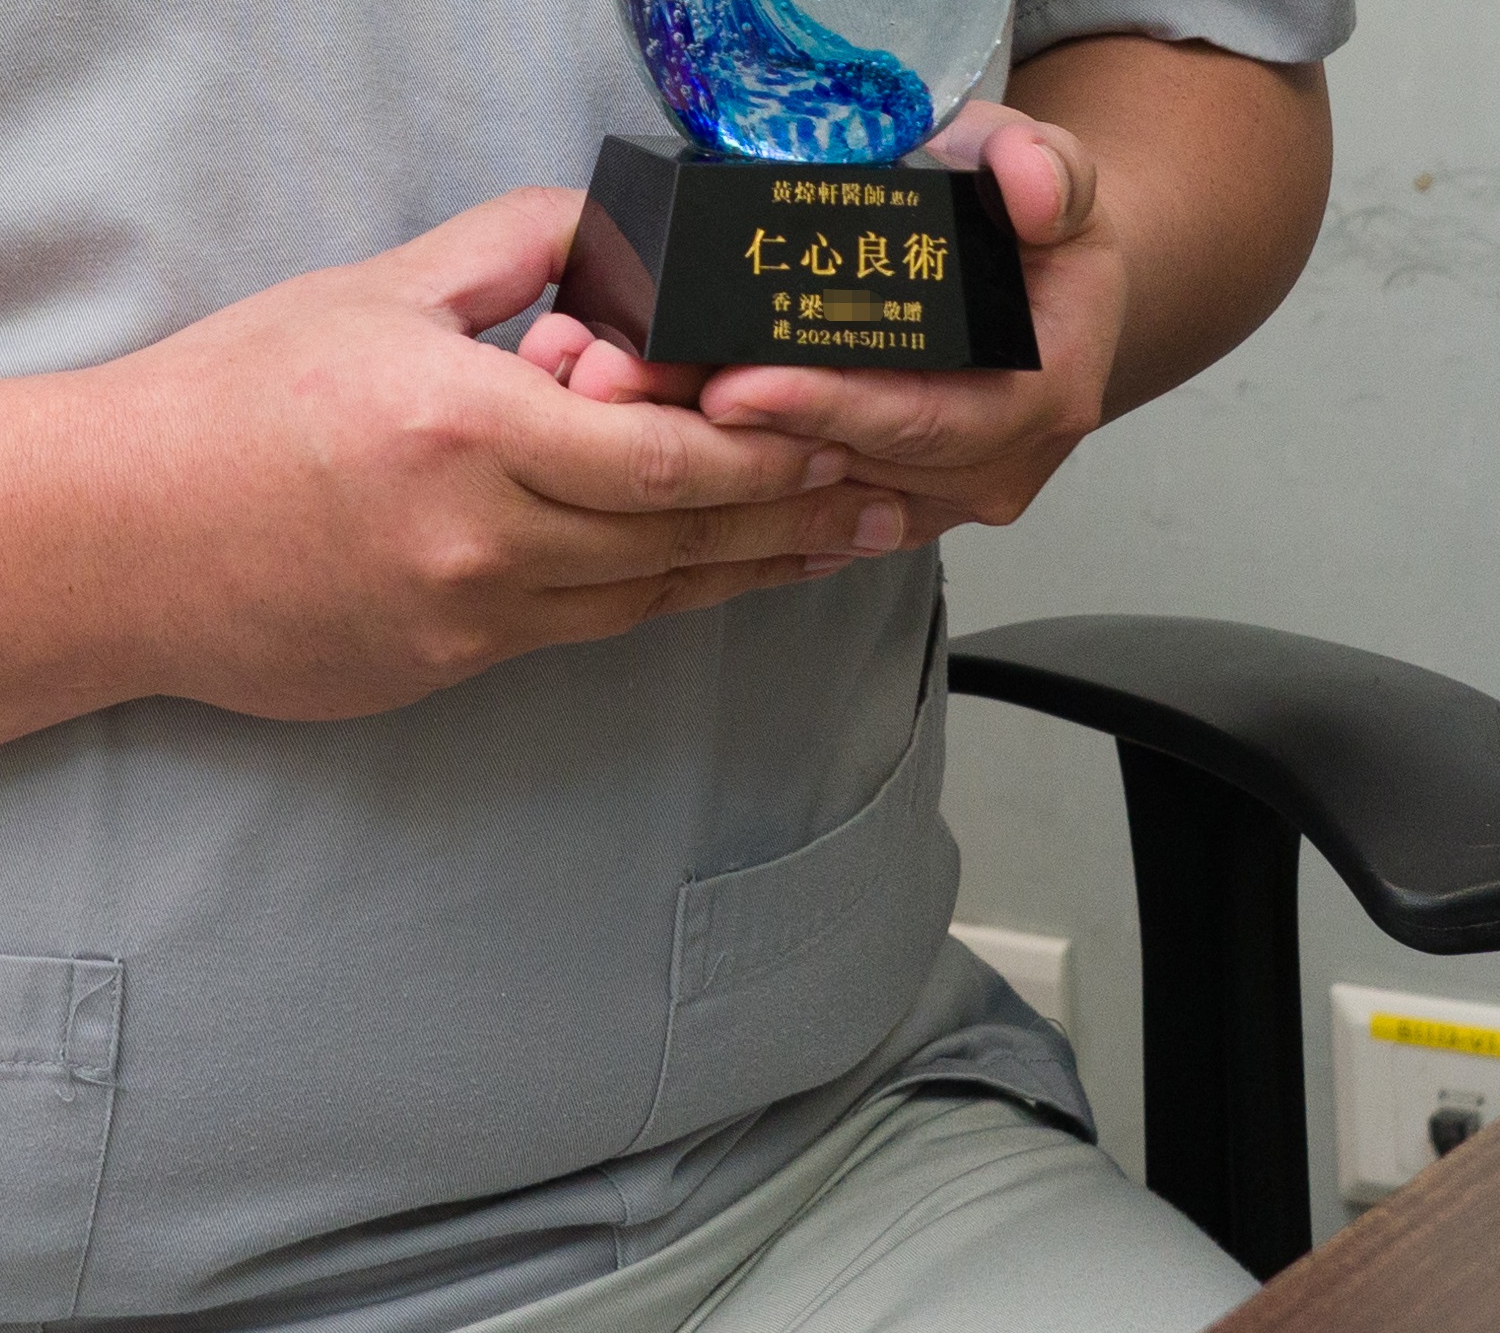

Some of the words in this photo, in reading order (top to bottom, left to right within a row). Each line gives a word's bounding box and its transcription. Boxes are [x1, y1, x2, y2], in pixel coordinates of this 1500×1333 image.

[744, 227, 950, 281] 仁心良術
[771, 291, 792, 341] 香港
[796, 329, 926, 351] 2024年5月11日
